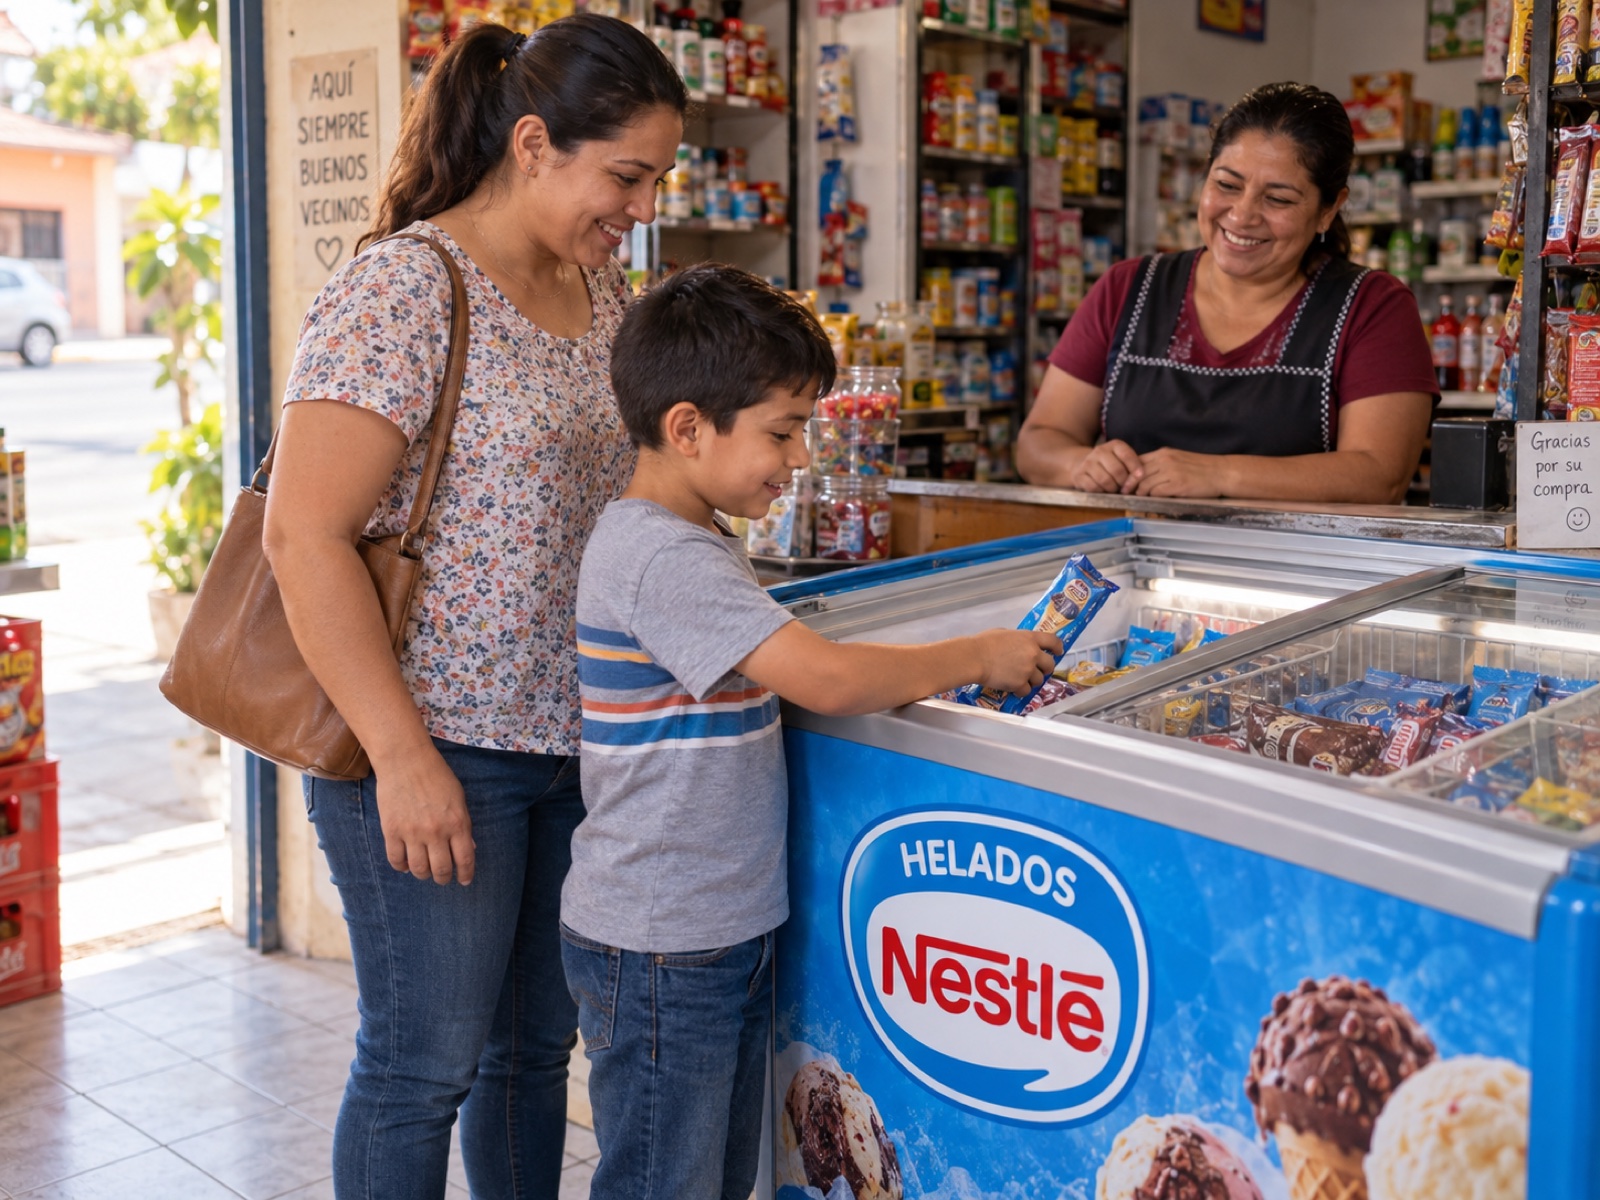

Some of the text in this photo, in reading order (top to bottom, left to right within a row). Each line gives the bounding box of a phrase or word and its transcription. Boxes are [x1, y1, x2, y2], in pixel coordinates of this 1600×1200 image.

[309, 61, 355, 101] AQUÍ
[298, 111, 370, 145] SIEMPRE
[300, 154, 368, 187] BUENOS
[300, 195, 370, 227] VECINOS
[1531, 431, 1591, 453] Gracias
[1535, 461, 1583, 479] por su
[1533, 483, 1593, 501] compra
[900, 839, 1077, 907] HELADOS
[882, 926, 1105, 1053] Nestlé
